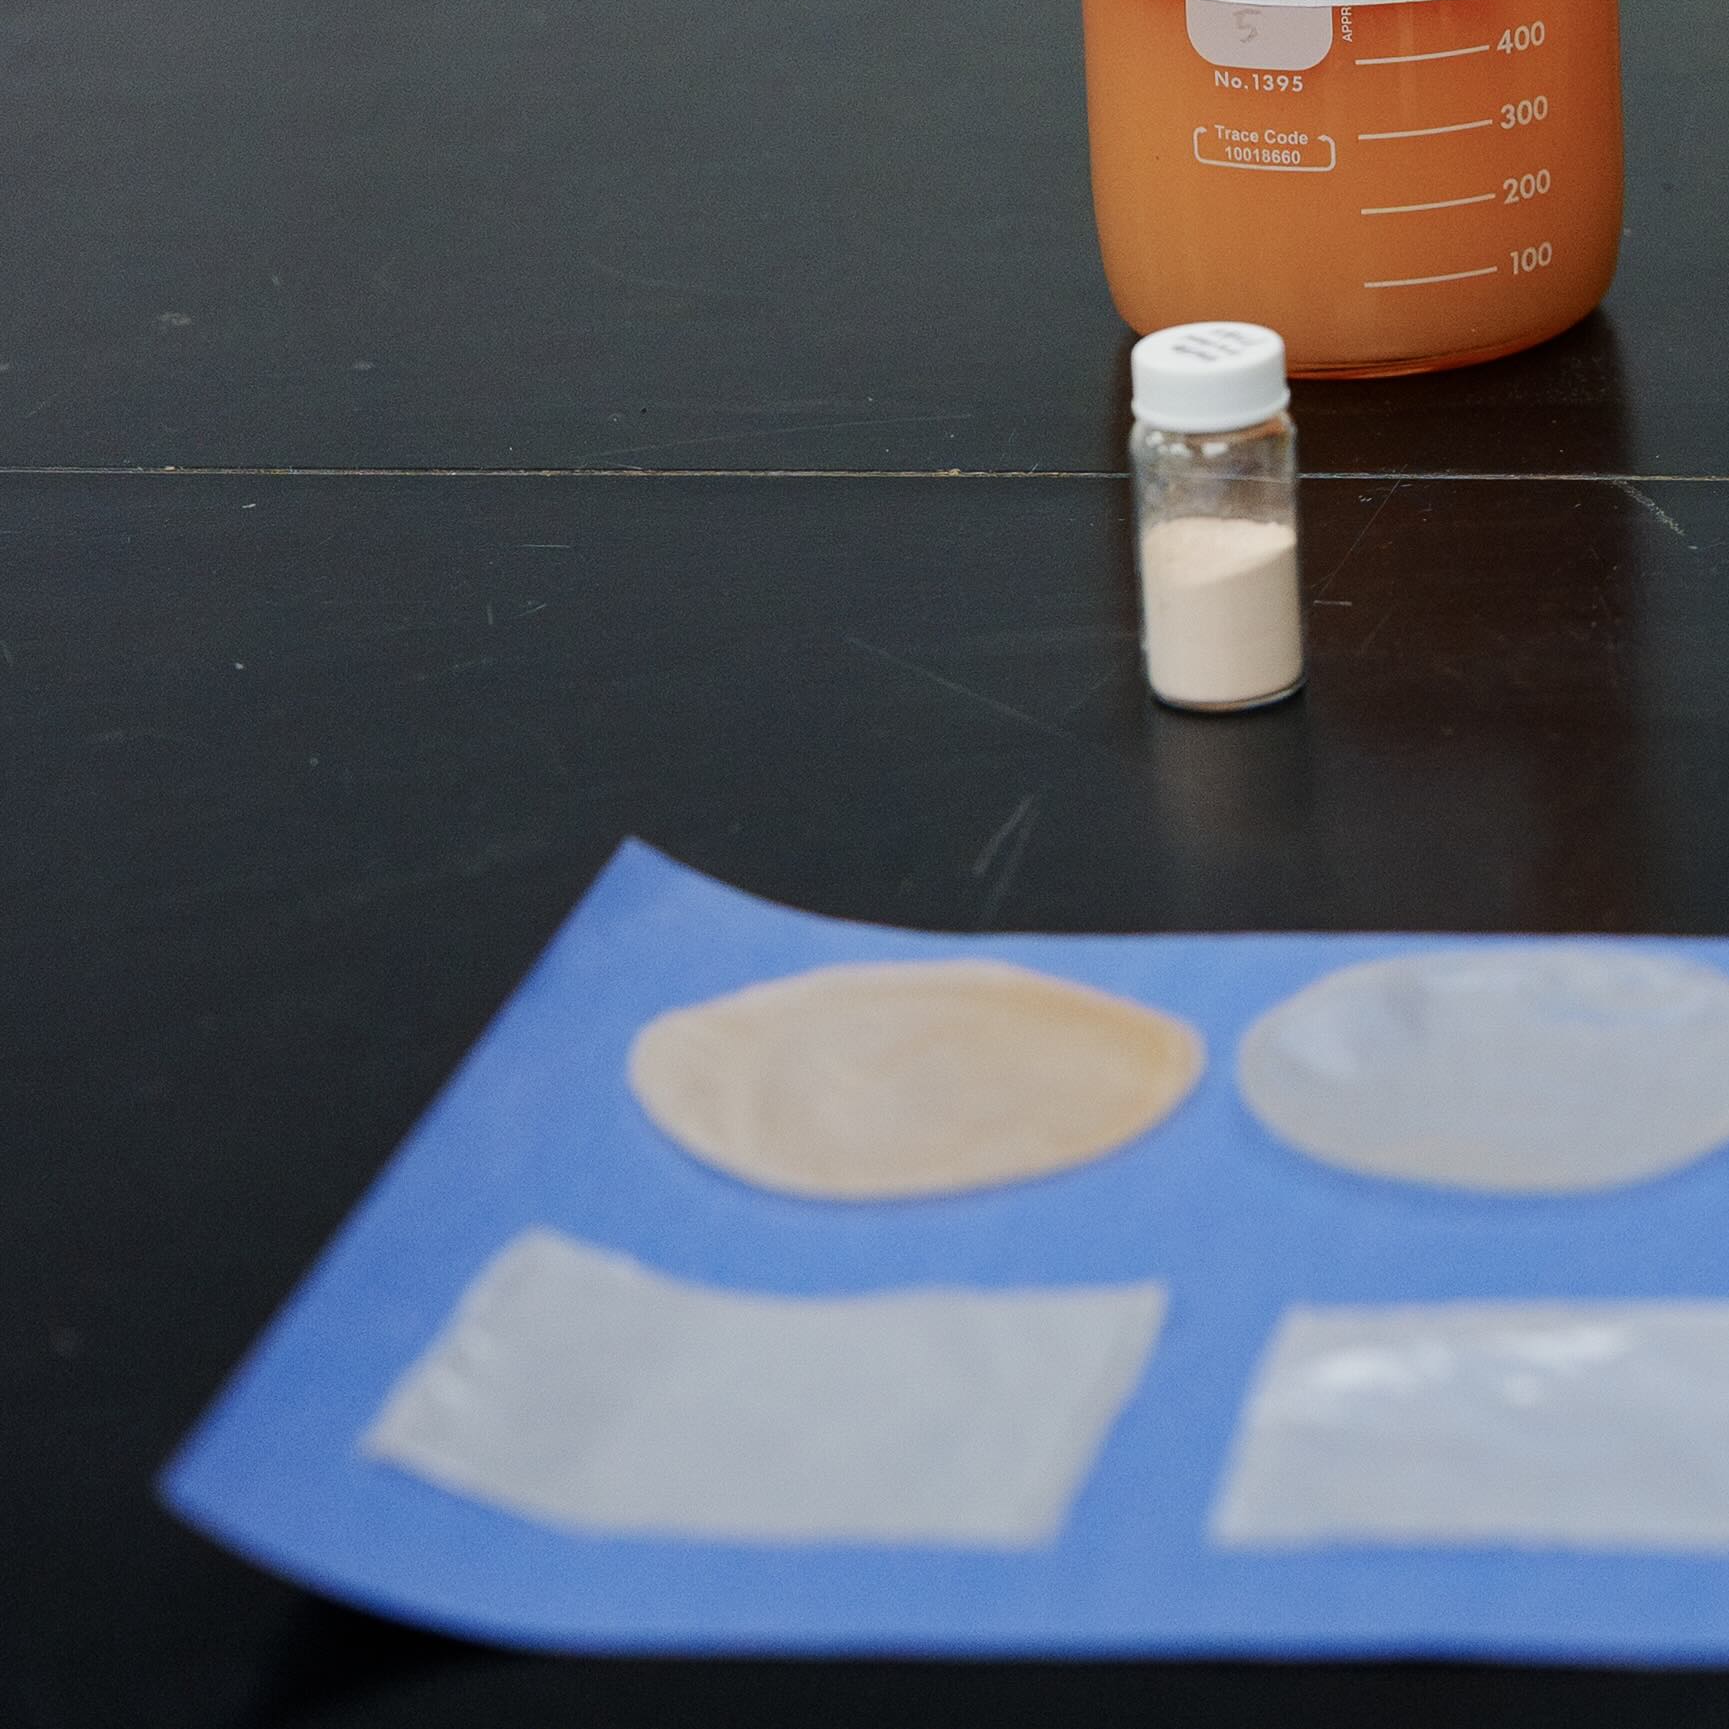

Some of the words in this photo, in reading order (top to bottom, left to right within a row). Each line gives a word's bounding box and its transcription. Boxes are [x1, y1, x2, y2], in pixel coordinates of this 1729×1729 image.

[1341, 6, 1353, 42] APPR
[1497, 21, 1545, 54] 400
[1501, 95, 1548, 129] 300
[1214, 124, 1258, 143] Trace
[1264, 129, 1309, 145] Code
[1225, 146, 1300, 164] 10018660
[1503, 169, 1551, 204] 200
[1510, 242, 1552, 275] 100
